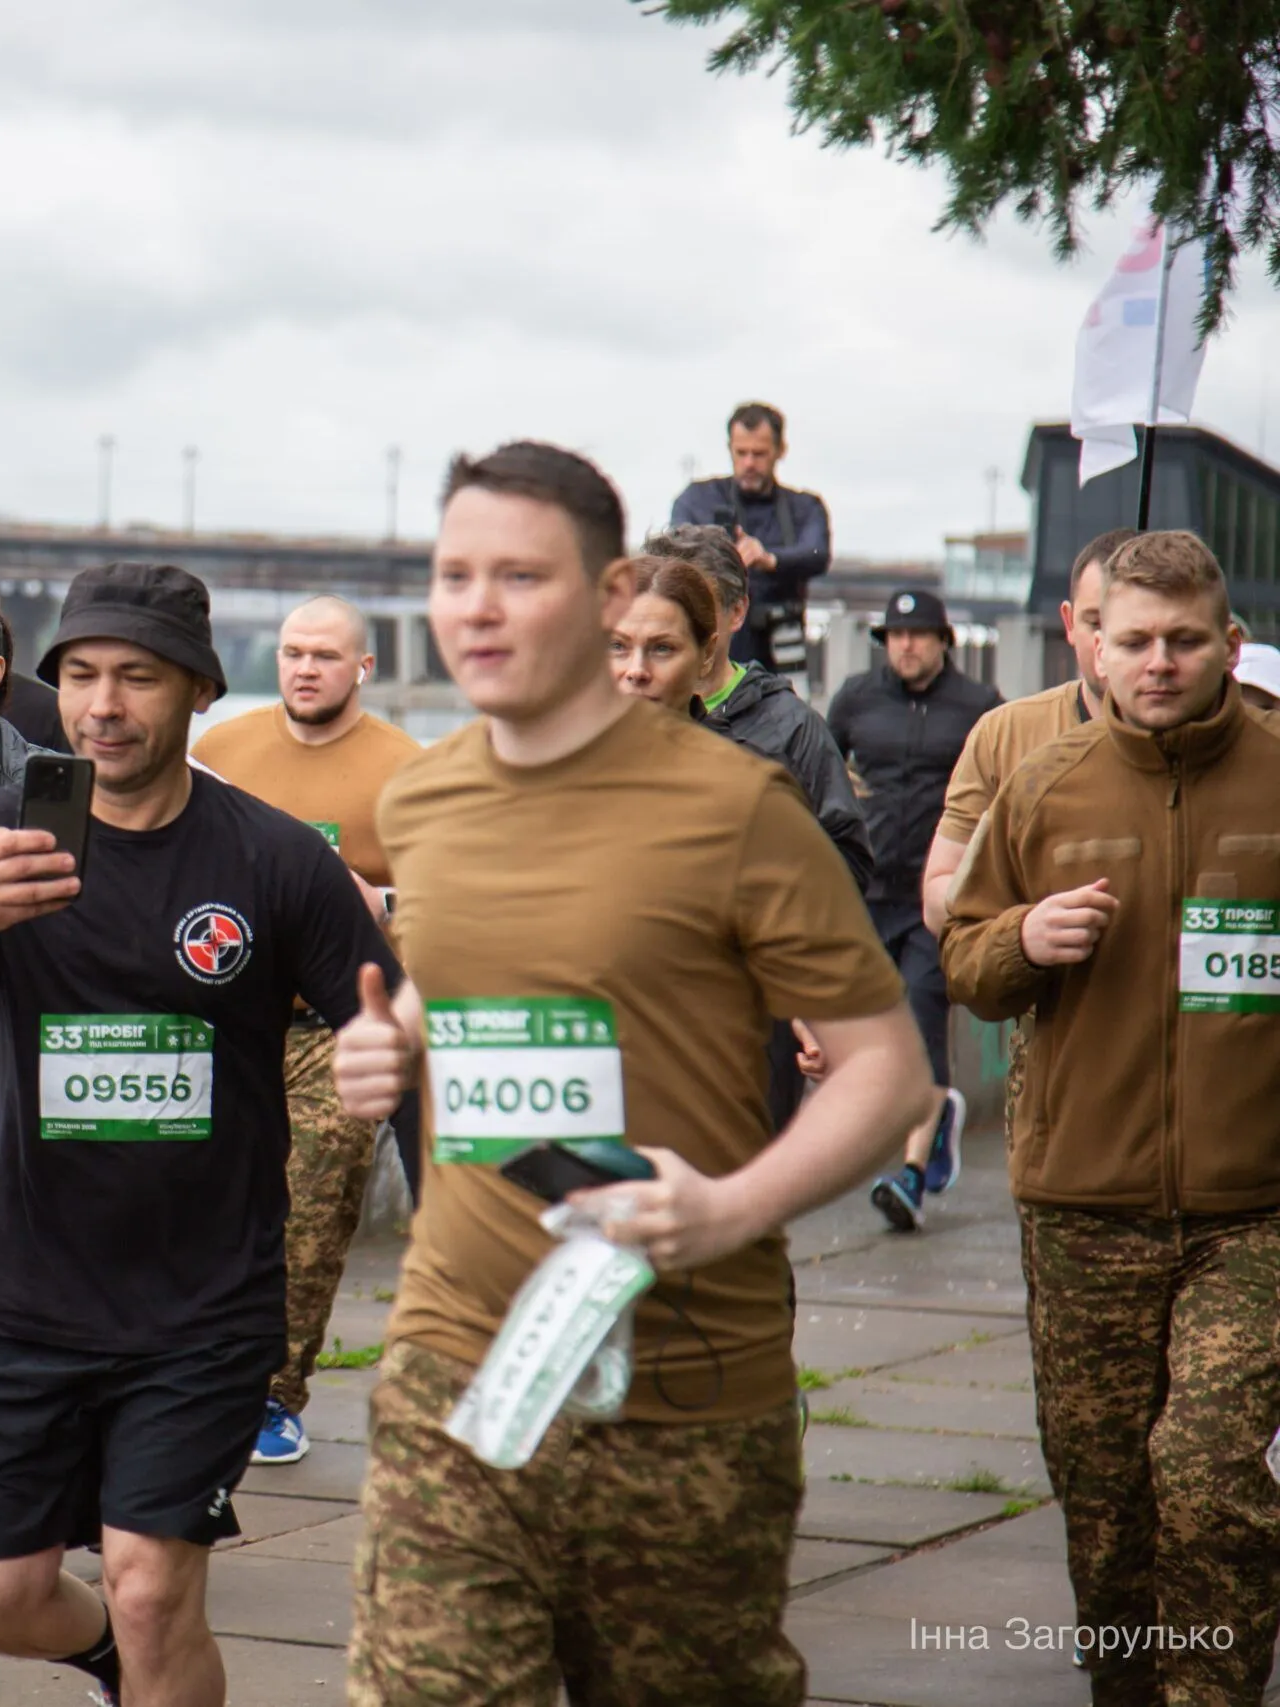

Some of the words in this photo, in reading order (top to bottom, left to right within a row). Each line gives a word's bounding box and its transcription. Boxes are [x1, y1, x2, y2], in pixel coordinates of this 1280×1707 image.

[1225, 908, 1274, 921] ПРОБІГ
[89, 1024, 147, 1039] ПРОБІГ
[64, 1073, 193, 1103] 09556
[445, 1077, 592, 1114] 04006
